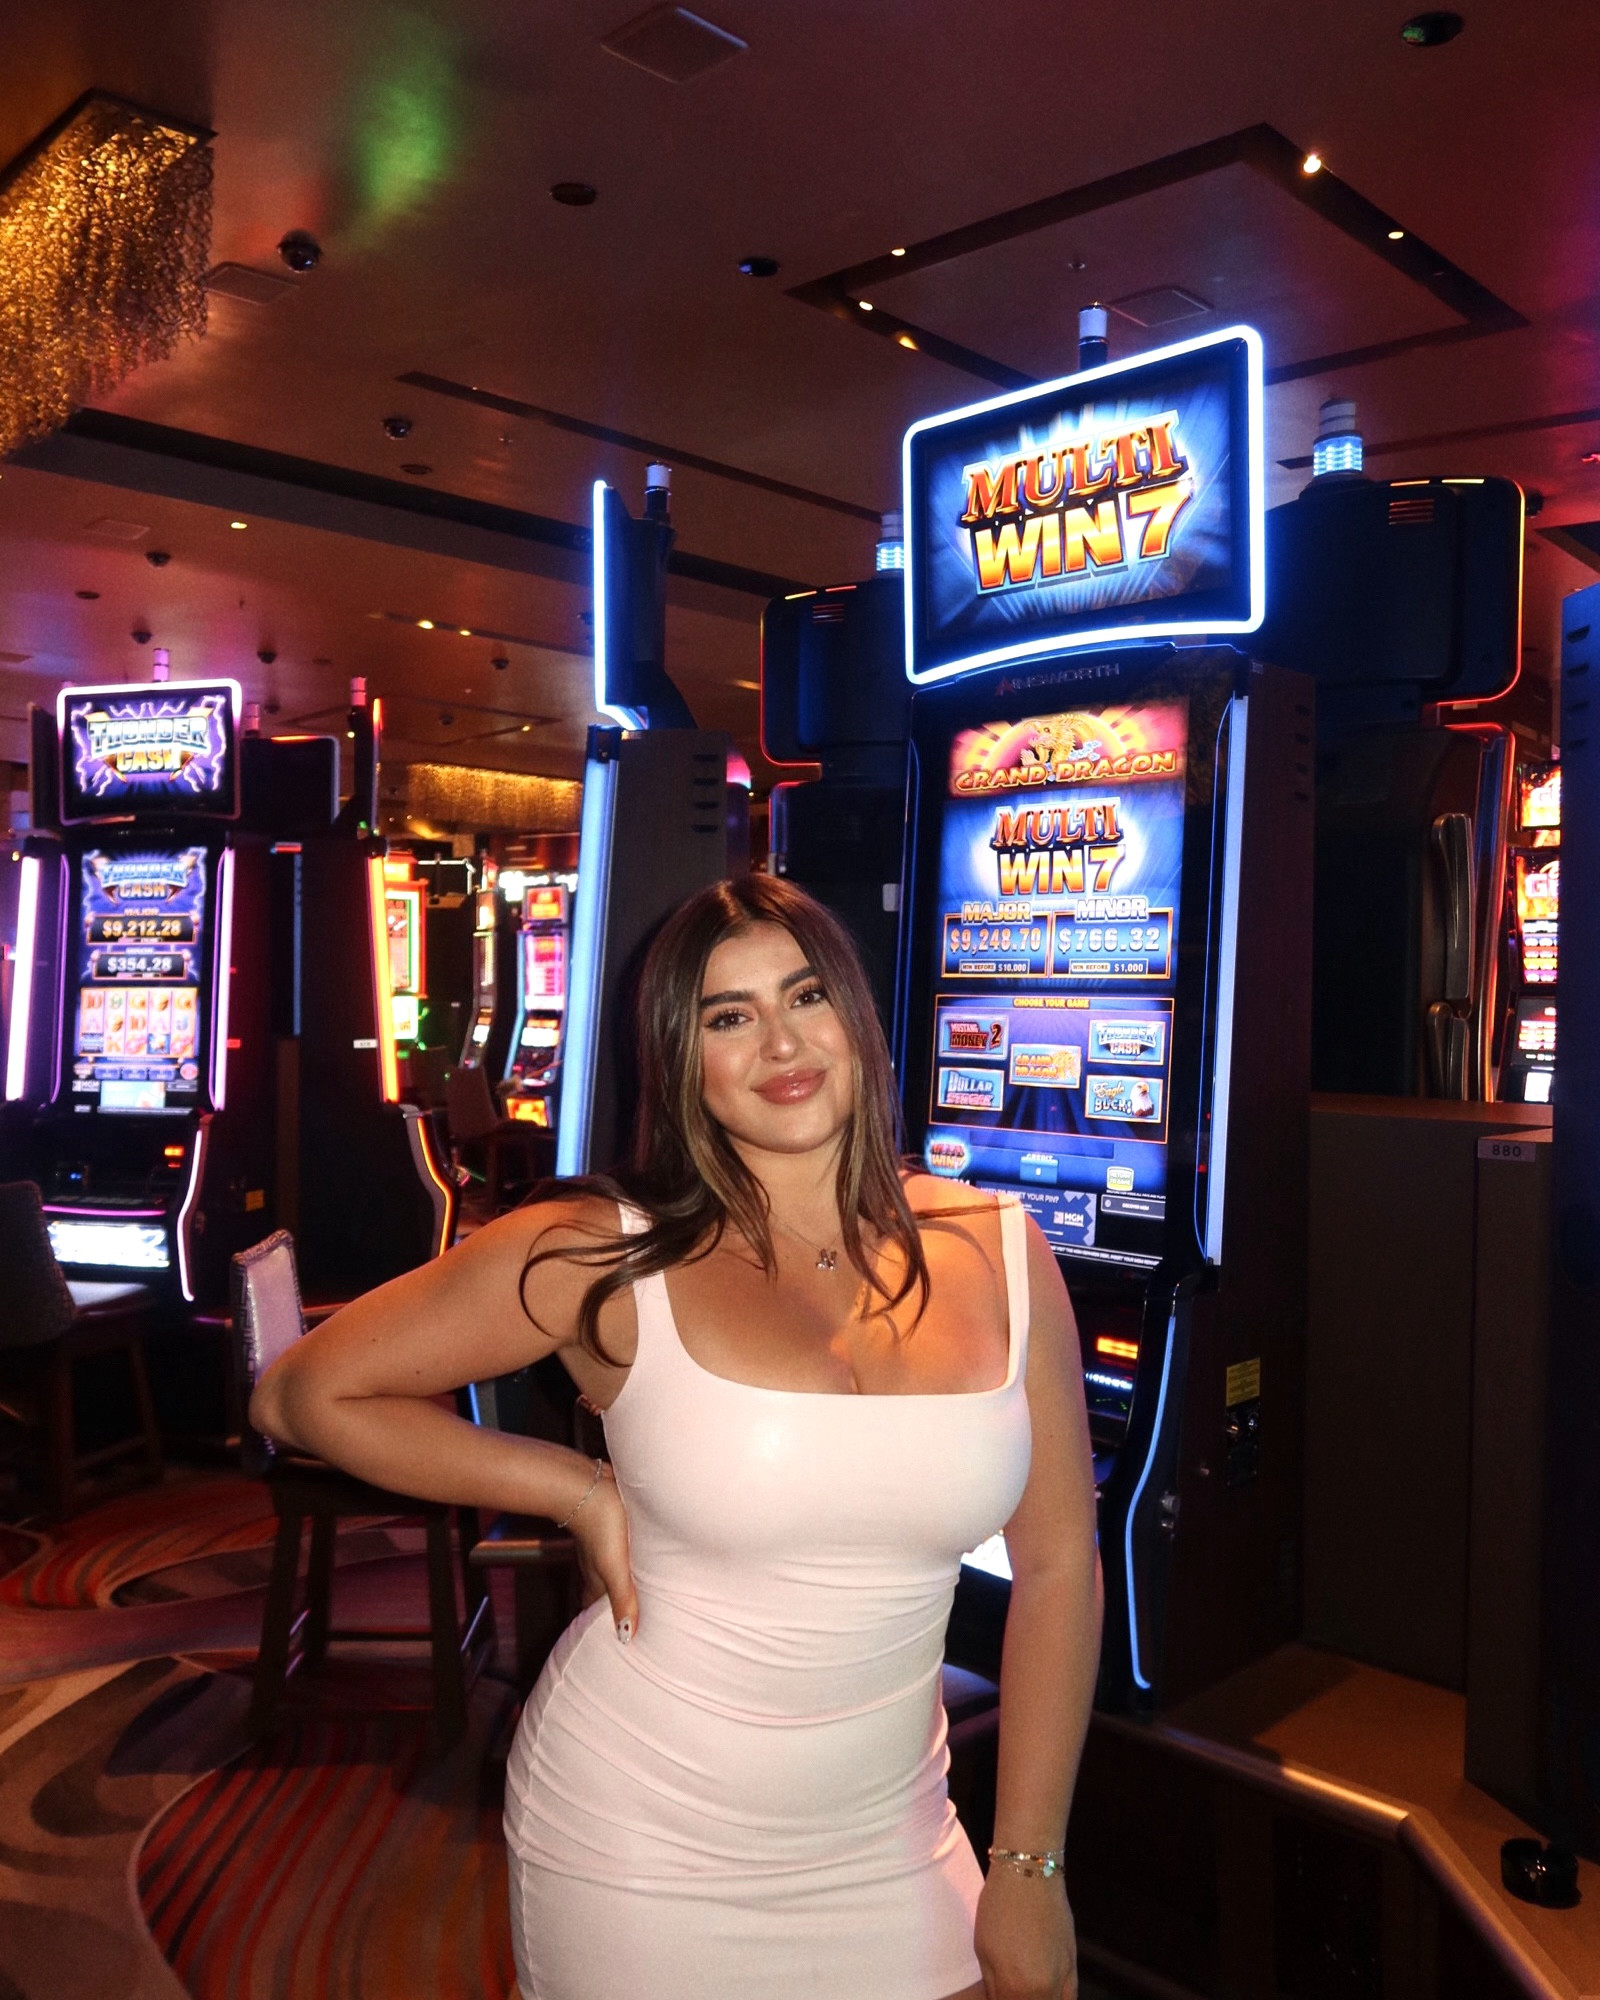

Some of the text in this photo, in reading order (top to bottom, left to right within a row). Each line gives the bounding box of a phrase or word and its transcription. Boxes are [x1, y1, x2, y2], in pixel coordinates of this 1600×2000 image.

[961, 415, 1185, 523] MULTI
[995, 662, 1120, 696] AINSWORTH
[89, 717, 208, 750] THUNDER
[116, 750, 181, 772] CASH
[954, 751, 1177, 792] GRAND DRAGON
[993, 802, 1123, 847] MULTI
[102, 862, 187, 883] THUNDER
[119, 882, 167, 899] CASH
[963, 902, 1032, 922] MAJOR
[1076, 898, 1148, 921] MINOR
[950, 927, 1042, 955] $9,248.70
[1059, 927, 1160, 954] $766.32
[107, 957, 172, 973] $354.28
[1013, 998, 1089, 1009] CHOOSE YOUR GAME
[951, 1022, 1003, 1048] MONEY 2
[1098, 1026, 1156, 1043] THUNDER
[1109, 1042, 1141, 1055] CASH
[1093, 1080, 1125, 1100] Eagle
[1492, 1144, 1521, 1157] 880
[1027, 1192, 1044, 1202] YOUR
[1065, 1212, 1084, 1224] MGM
